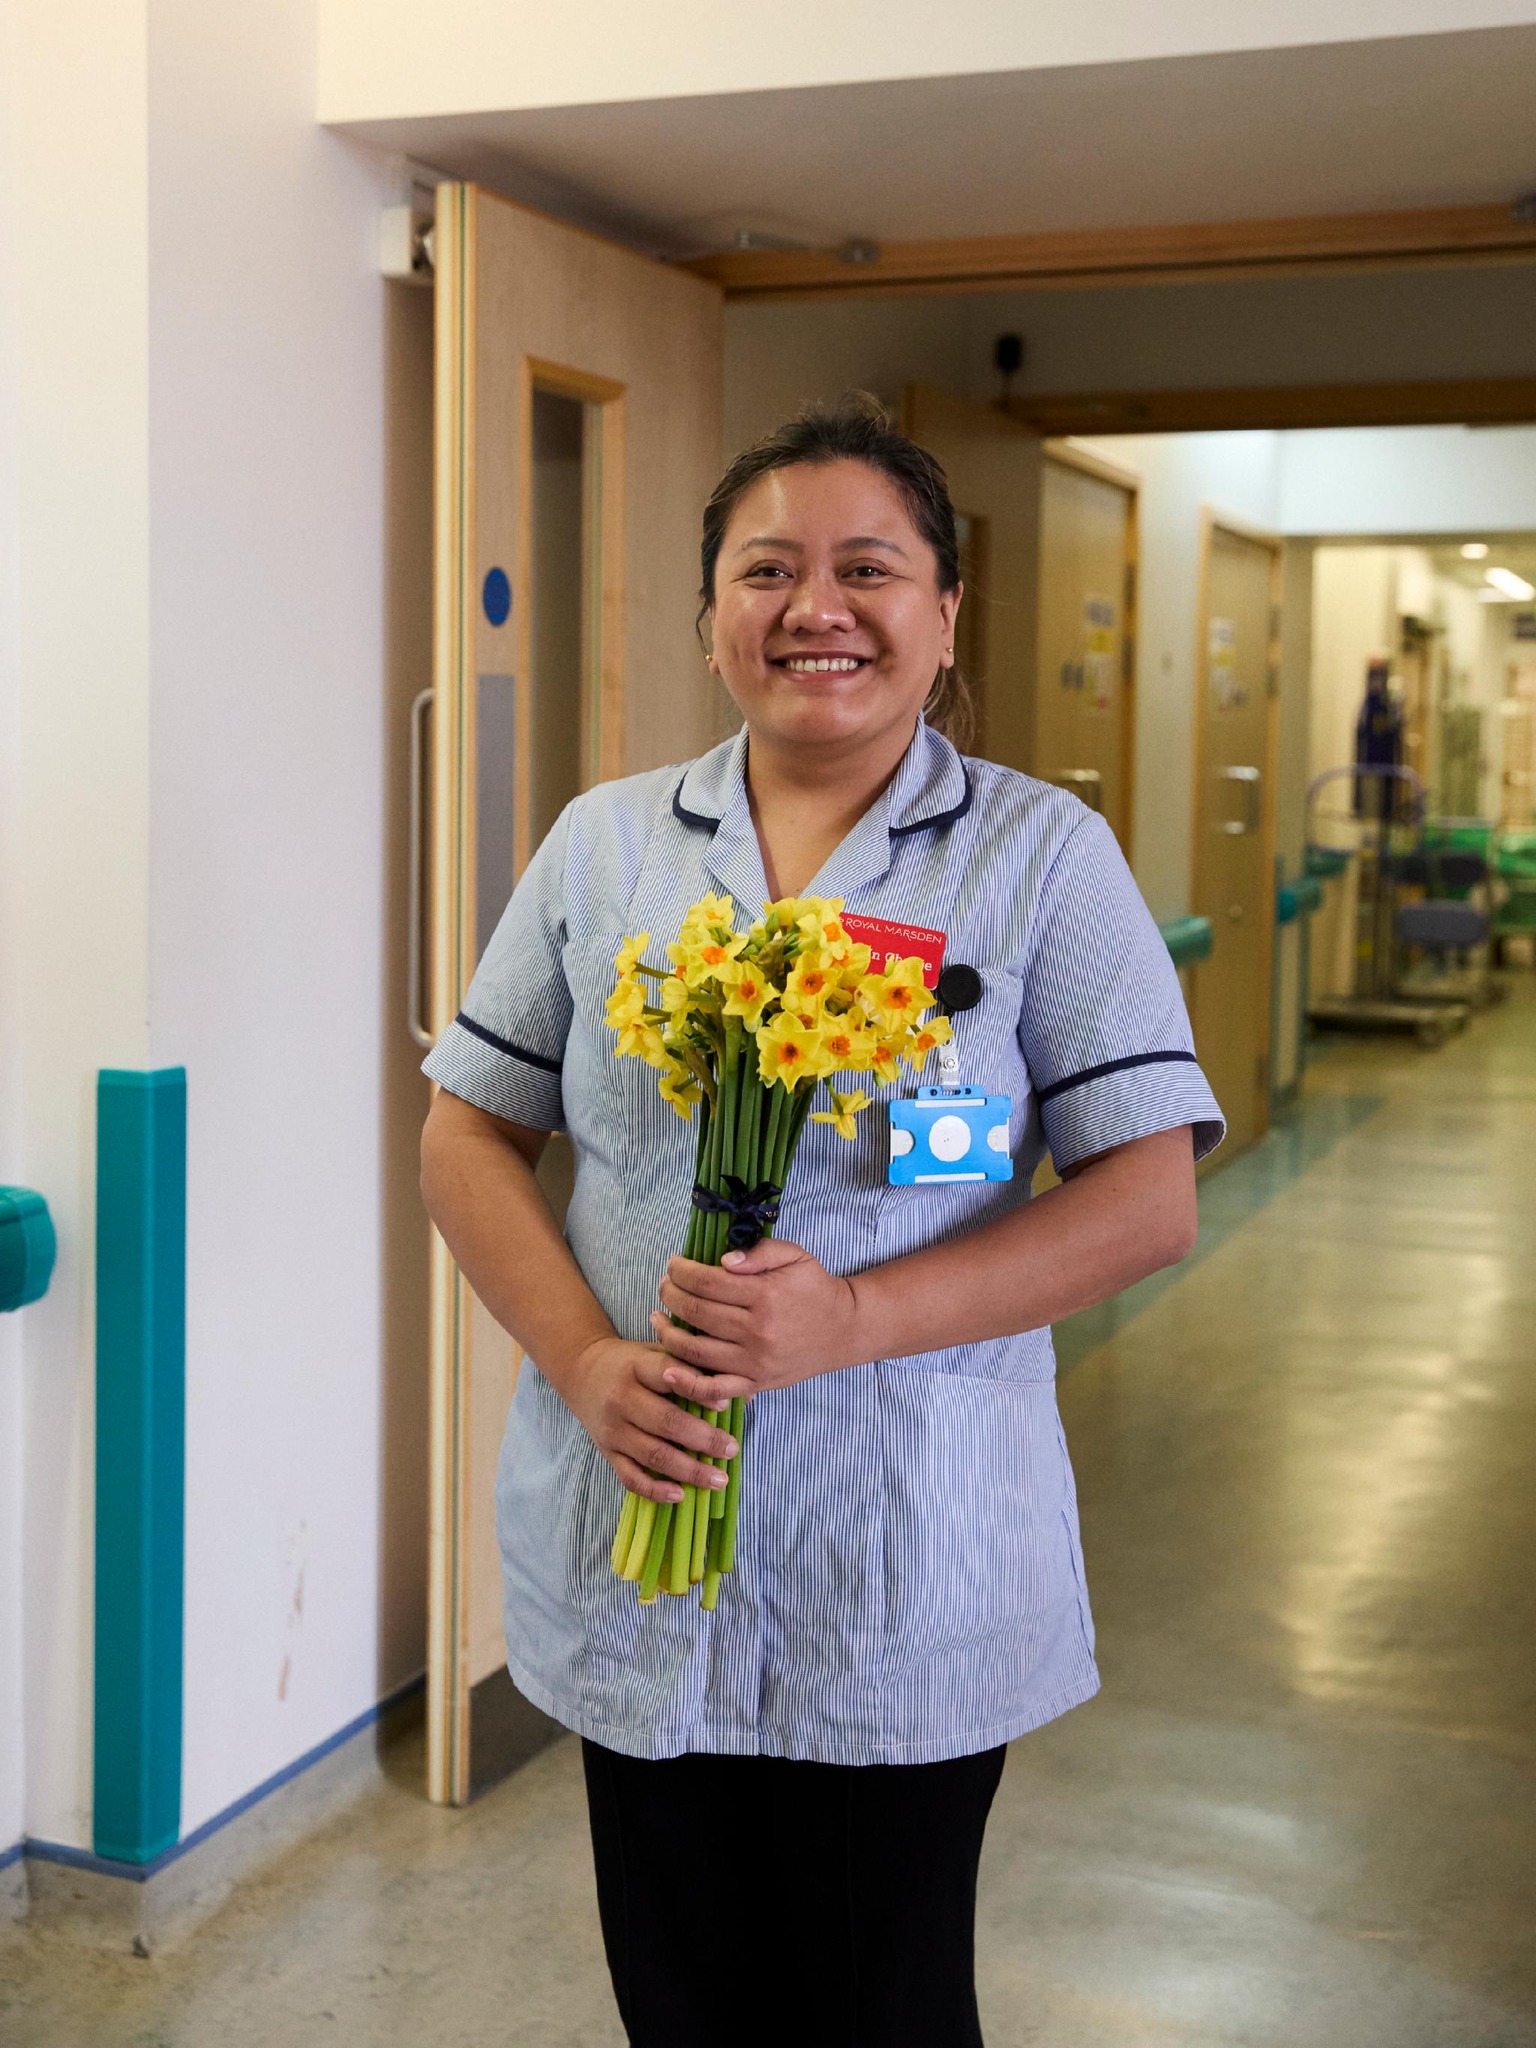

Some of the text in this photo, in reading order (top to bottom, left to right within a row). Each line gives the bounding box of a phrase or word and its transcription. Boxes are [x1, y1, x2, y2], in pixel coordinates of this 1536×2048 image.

[846, 918, 882, 932] ROYAL
[884, 925, 942, 944] MARSDEN
[870, 948, 881, 961] n
